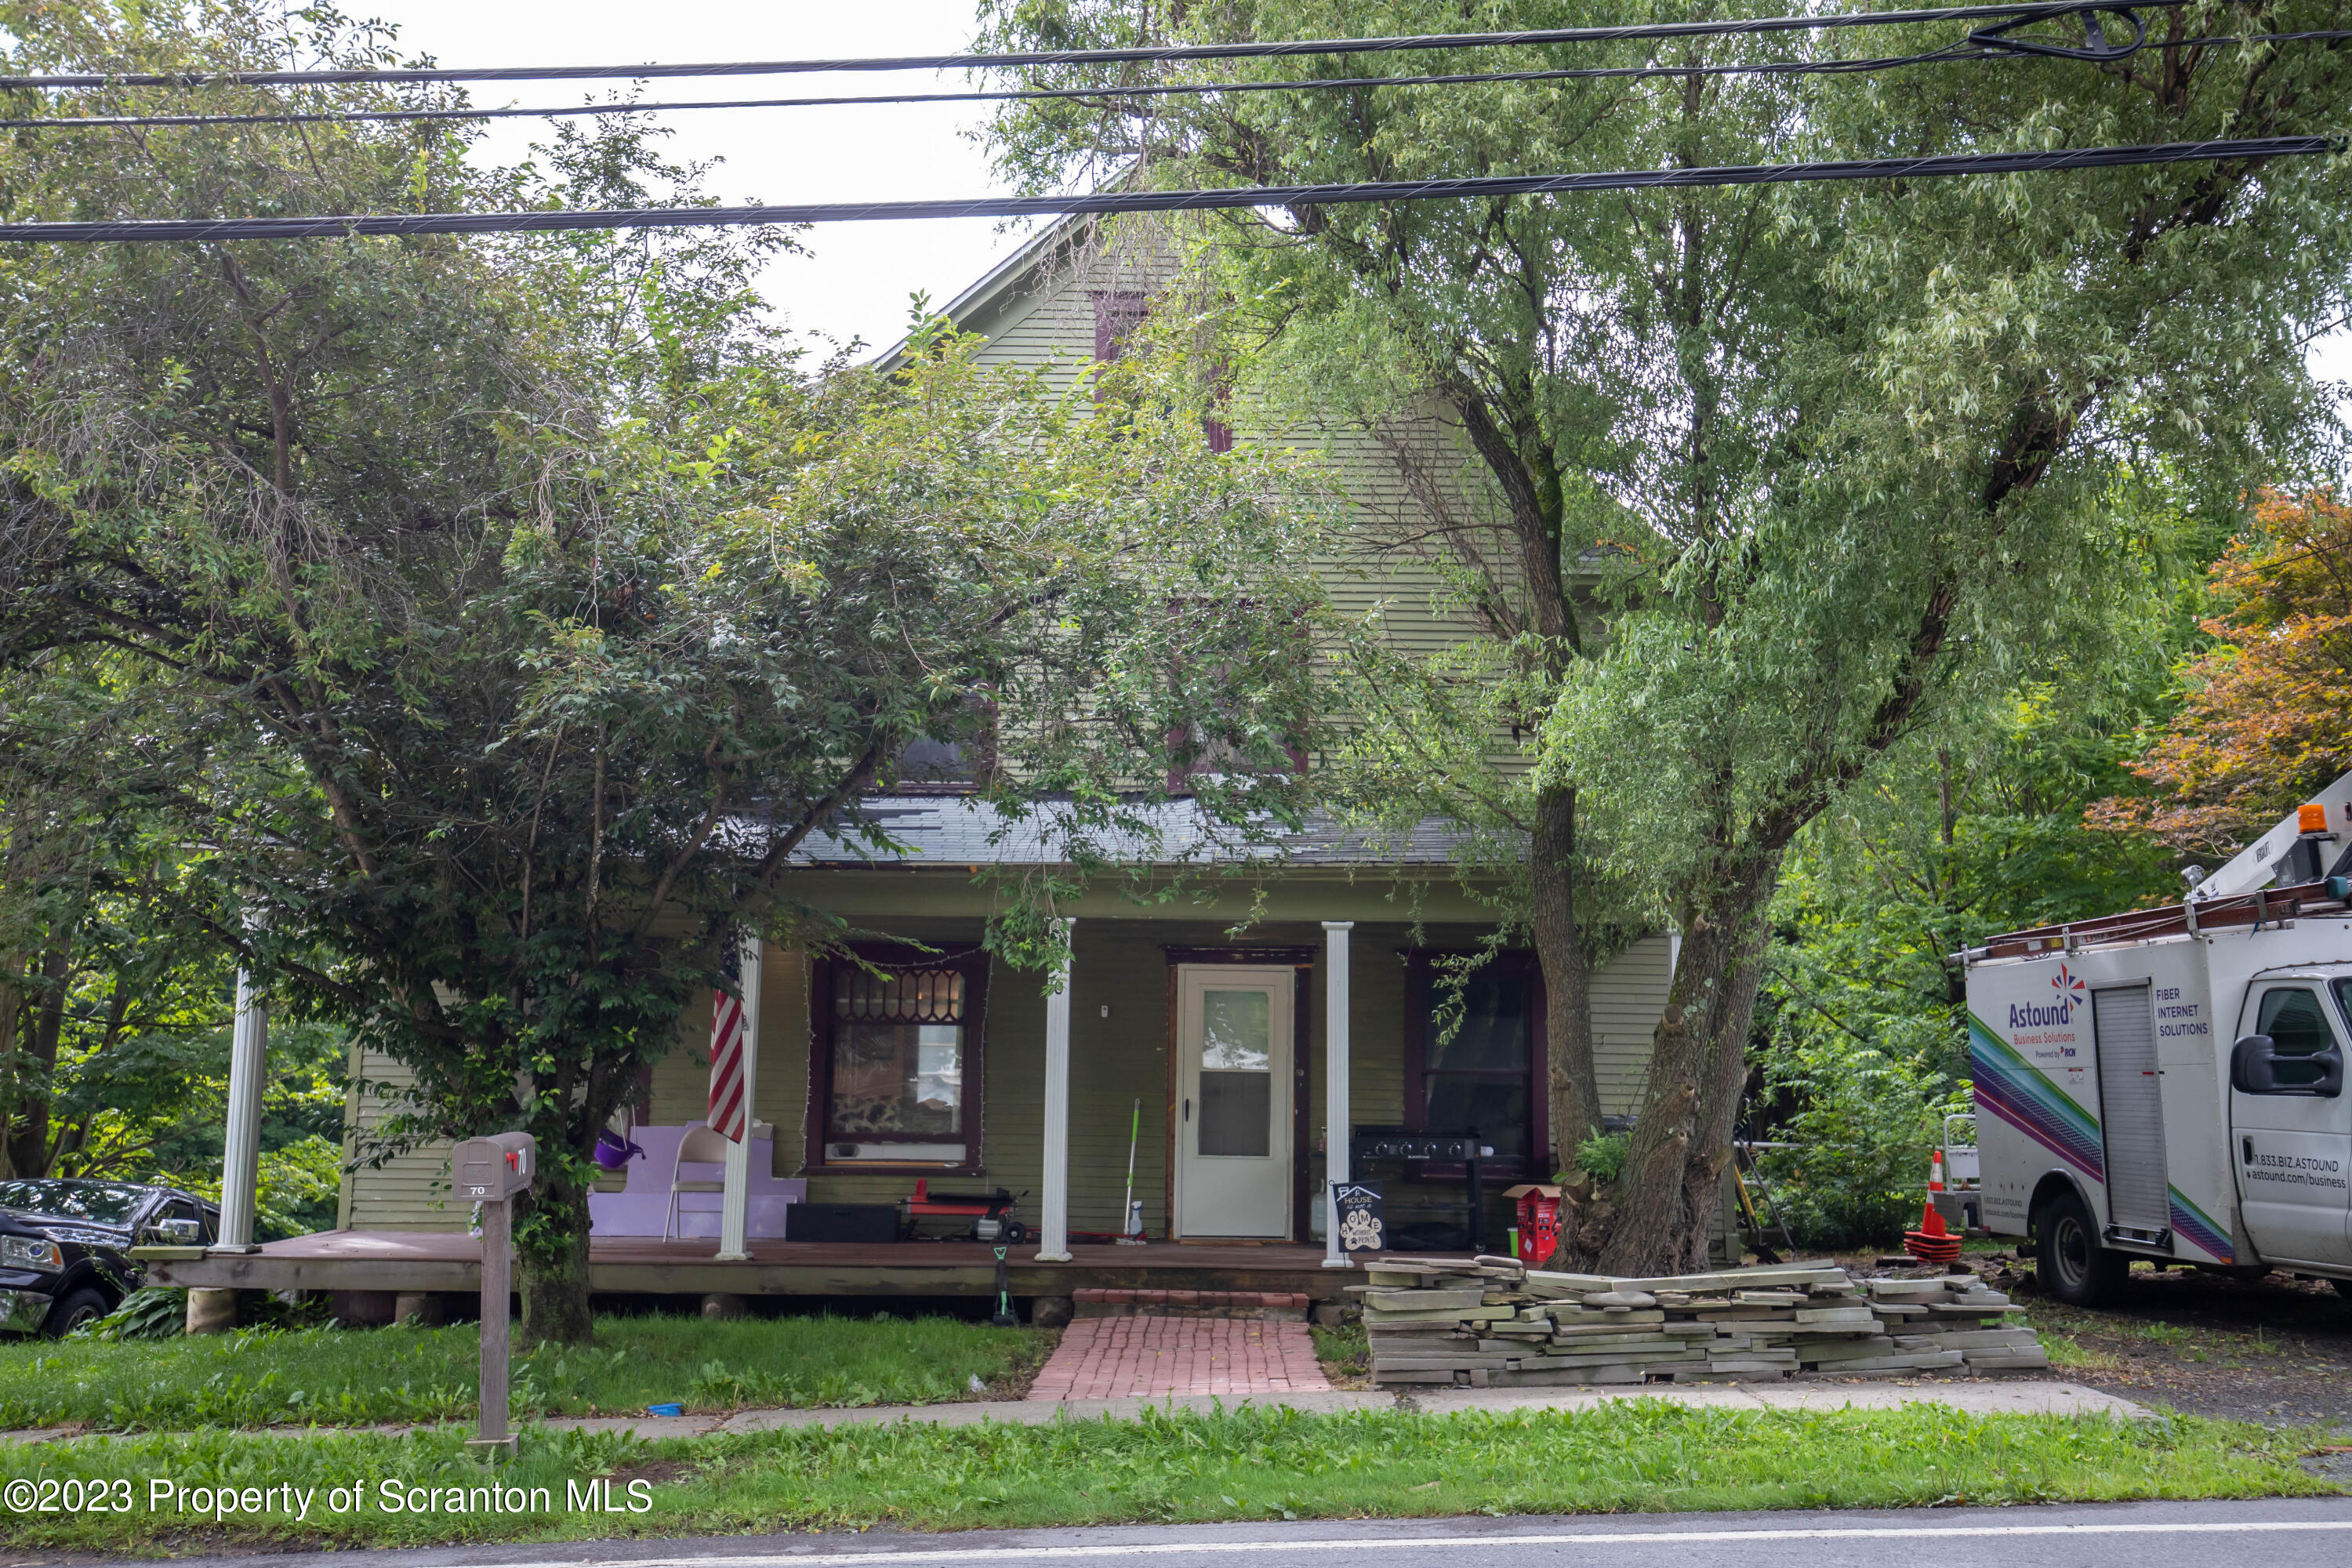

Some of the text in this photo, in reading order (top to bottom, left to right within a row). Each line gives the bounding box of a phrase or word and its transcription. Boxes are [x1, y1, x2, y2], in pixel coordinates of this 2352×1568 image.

[2156, 988, 2180, 1000] FIBER
[2009, 997, 2069, 1029] Astound
[2158, 1004, 2198, 1018] INTERNET
[2160, 1022, 2208, 1036] SOLUTIONS
[2013, 1032, 2075, 1045] Business Solutions
[2054, 1051, 2060, 1059] by
[2064, 1048, 2076, 1058] RCN
[518, 1148, 526, 1176] 70
[2254, 1154, 2339, 1172] 1.833.BIZ.ASTOUND
[2252, 1170, 2347, 1189] astound.com/business
[470, 1186, 485, 1196] 70
